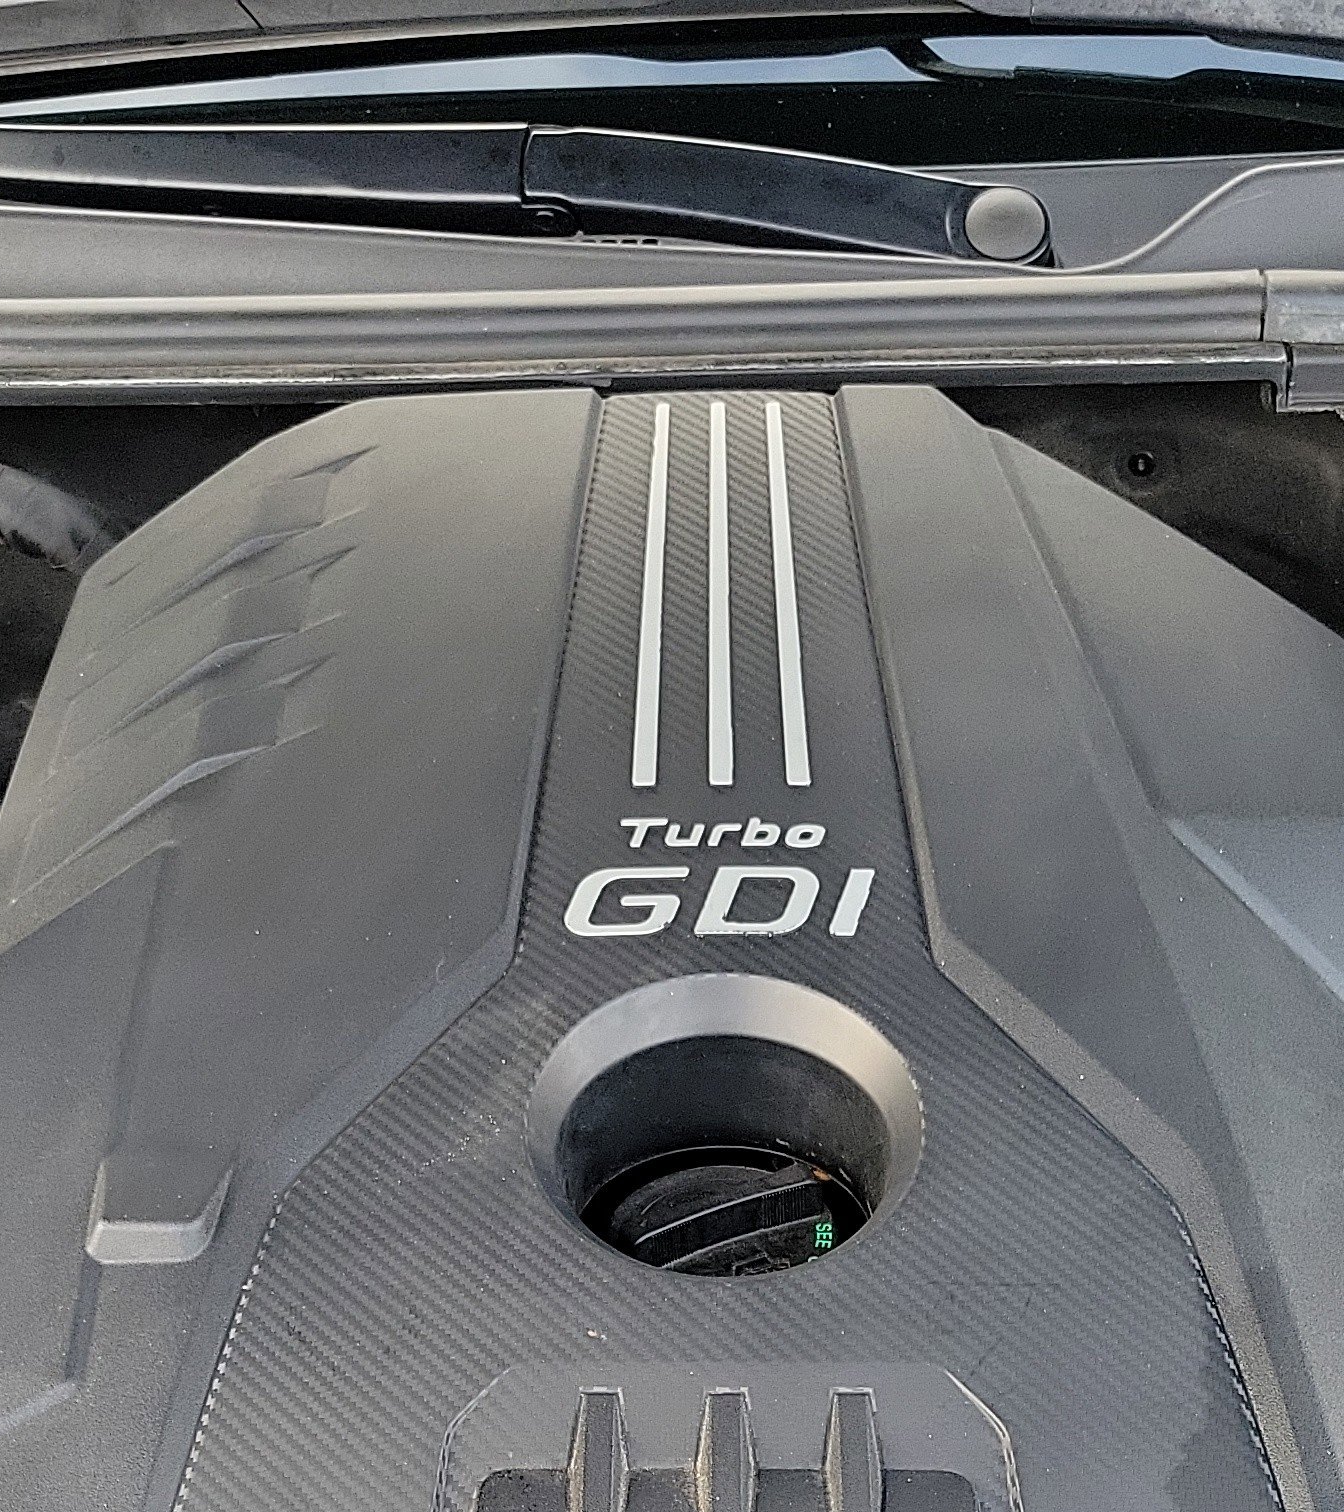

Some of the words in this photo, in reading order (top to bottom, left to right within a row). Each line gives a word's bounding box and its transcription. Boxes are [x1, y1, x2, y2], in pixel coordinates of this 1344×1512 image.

[620, 817, 826, 848] Turbo
[564, 866, 875, 937] GDI
[815, 1223, 833, 1249] SEE
